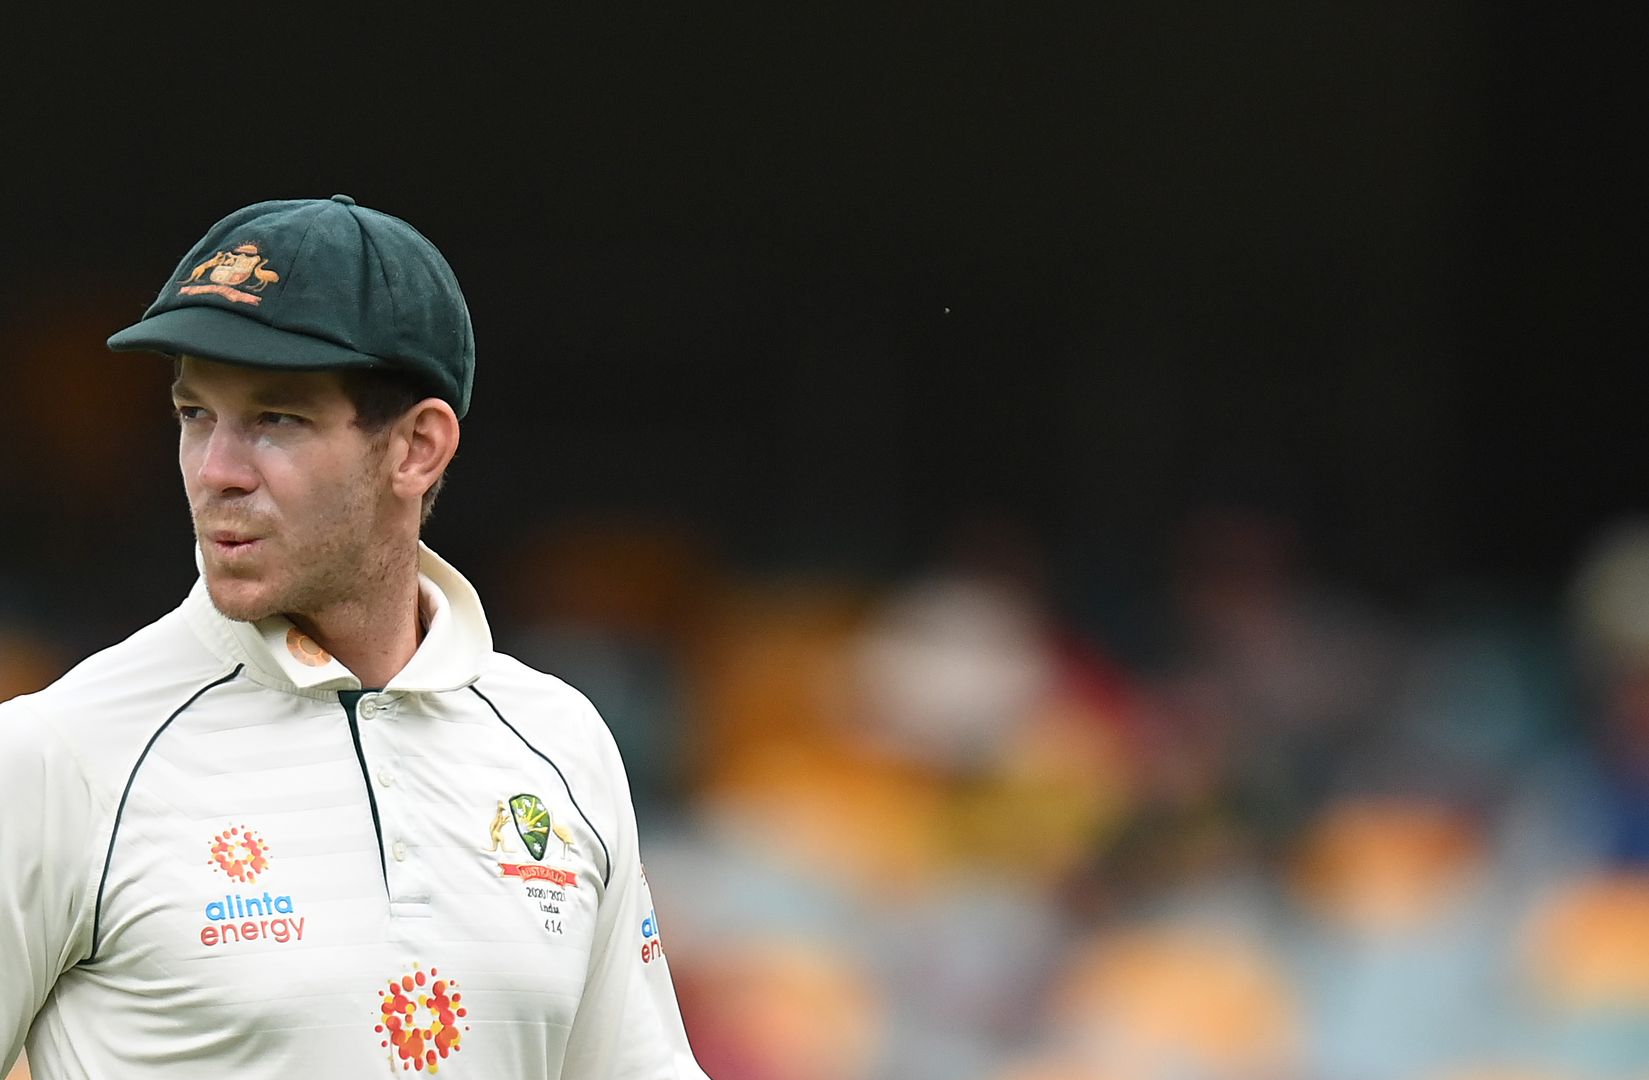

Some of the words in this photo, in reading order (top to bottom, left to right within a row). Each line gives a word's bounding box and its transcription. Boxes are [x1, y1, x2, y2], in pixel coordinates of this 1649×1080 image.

[520, 866, 565, 883] AUSTRALIA
[526, 887, 566, 902] 2020/2021
[205, 892, 294, 921] alinta
[539, 901, 560, 914] India
[200, 917, 305, 946] energy
[545, 919, 563, 934] 414
[641, 938, 662, 963] en
